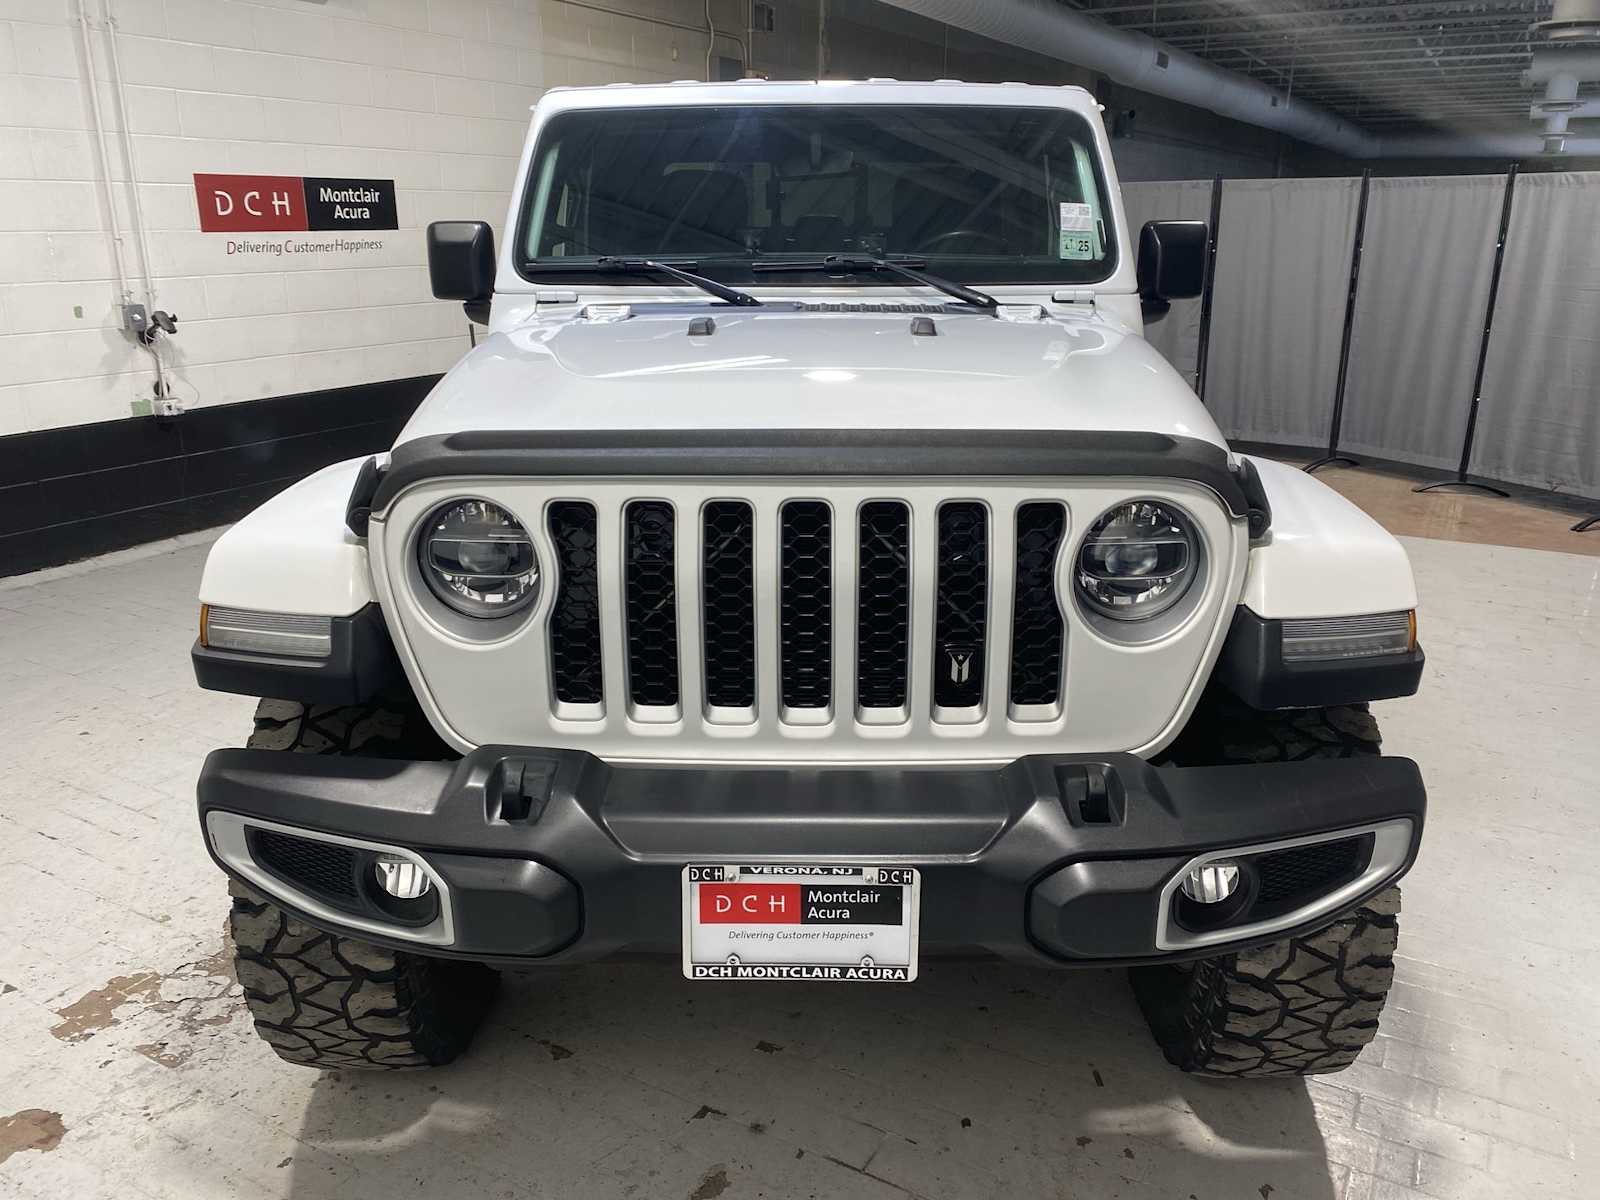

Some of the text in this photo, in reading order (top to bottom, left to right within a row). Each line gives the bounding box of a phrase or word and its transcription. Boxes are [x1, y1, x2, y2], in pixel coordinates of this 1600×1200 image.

[319, 187, 380, 203] Montclair
[214, 190, 291, 216] DCH
[334, 204, 371, 220] Acura
[226, 238, 383, 257] Delivering Customer Happiness
[1078, 240, 1090, 252] 25
[690, 868, 723, 880] DCH
[750, 866, 853, 875] VERONA, NJ
[879, 870, 912, 883] DCH
[807, 889, 881, 903] Montclair
[716, 894, 785, 913] DCH
[807, 906, 850, 919] Acura
[728, 930, 774, 941] Delivering
[776, 930, 820, 940] Customer
[695, 966, 906, 980] DCH MONTCLAIR ACURA
